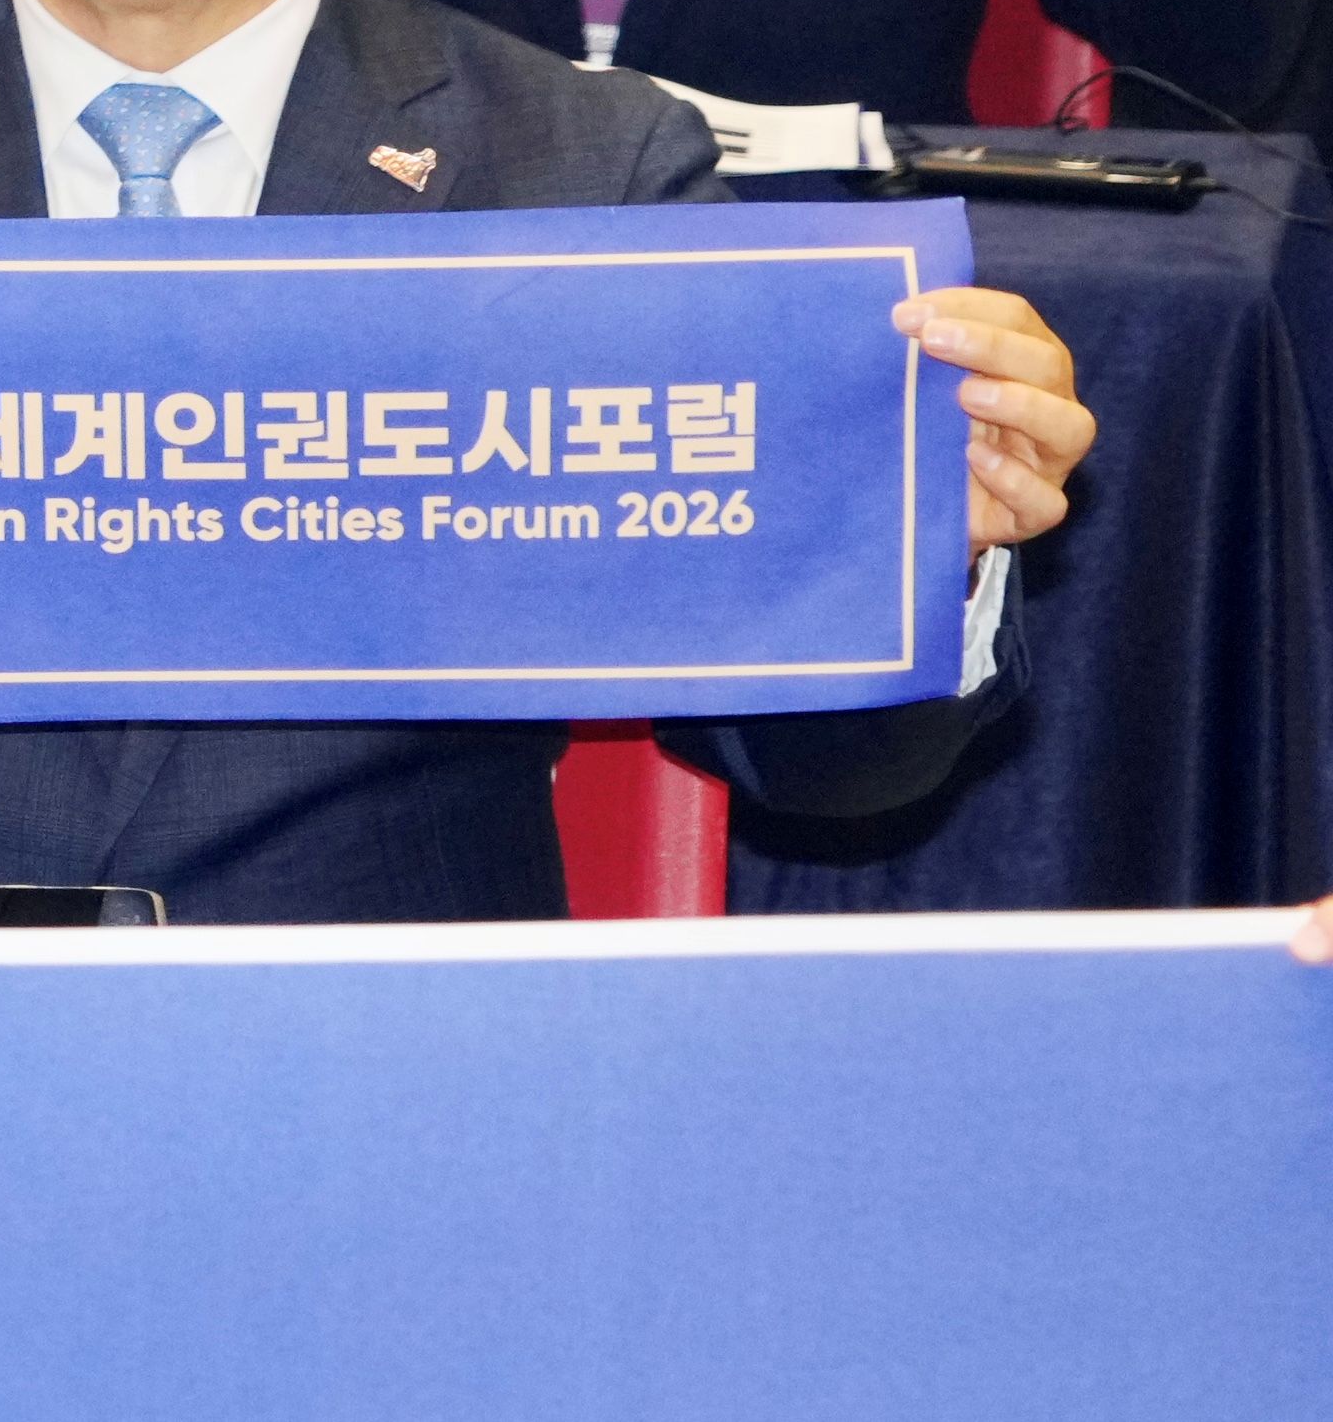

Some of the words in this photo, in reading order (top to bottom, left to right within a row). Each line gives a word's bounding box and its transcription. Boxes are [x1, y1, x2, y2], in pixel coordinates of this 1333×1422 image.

[44, 496, 225, 555] Rights
[240, 495, 405, 543] Cities
[422, 494, 601, 541] Forum
[616, 489, 756, 539] 2026
